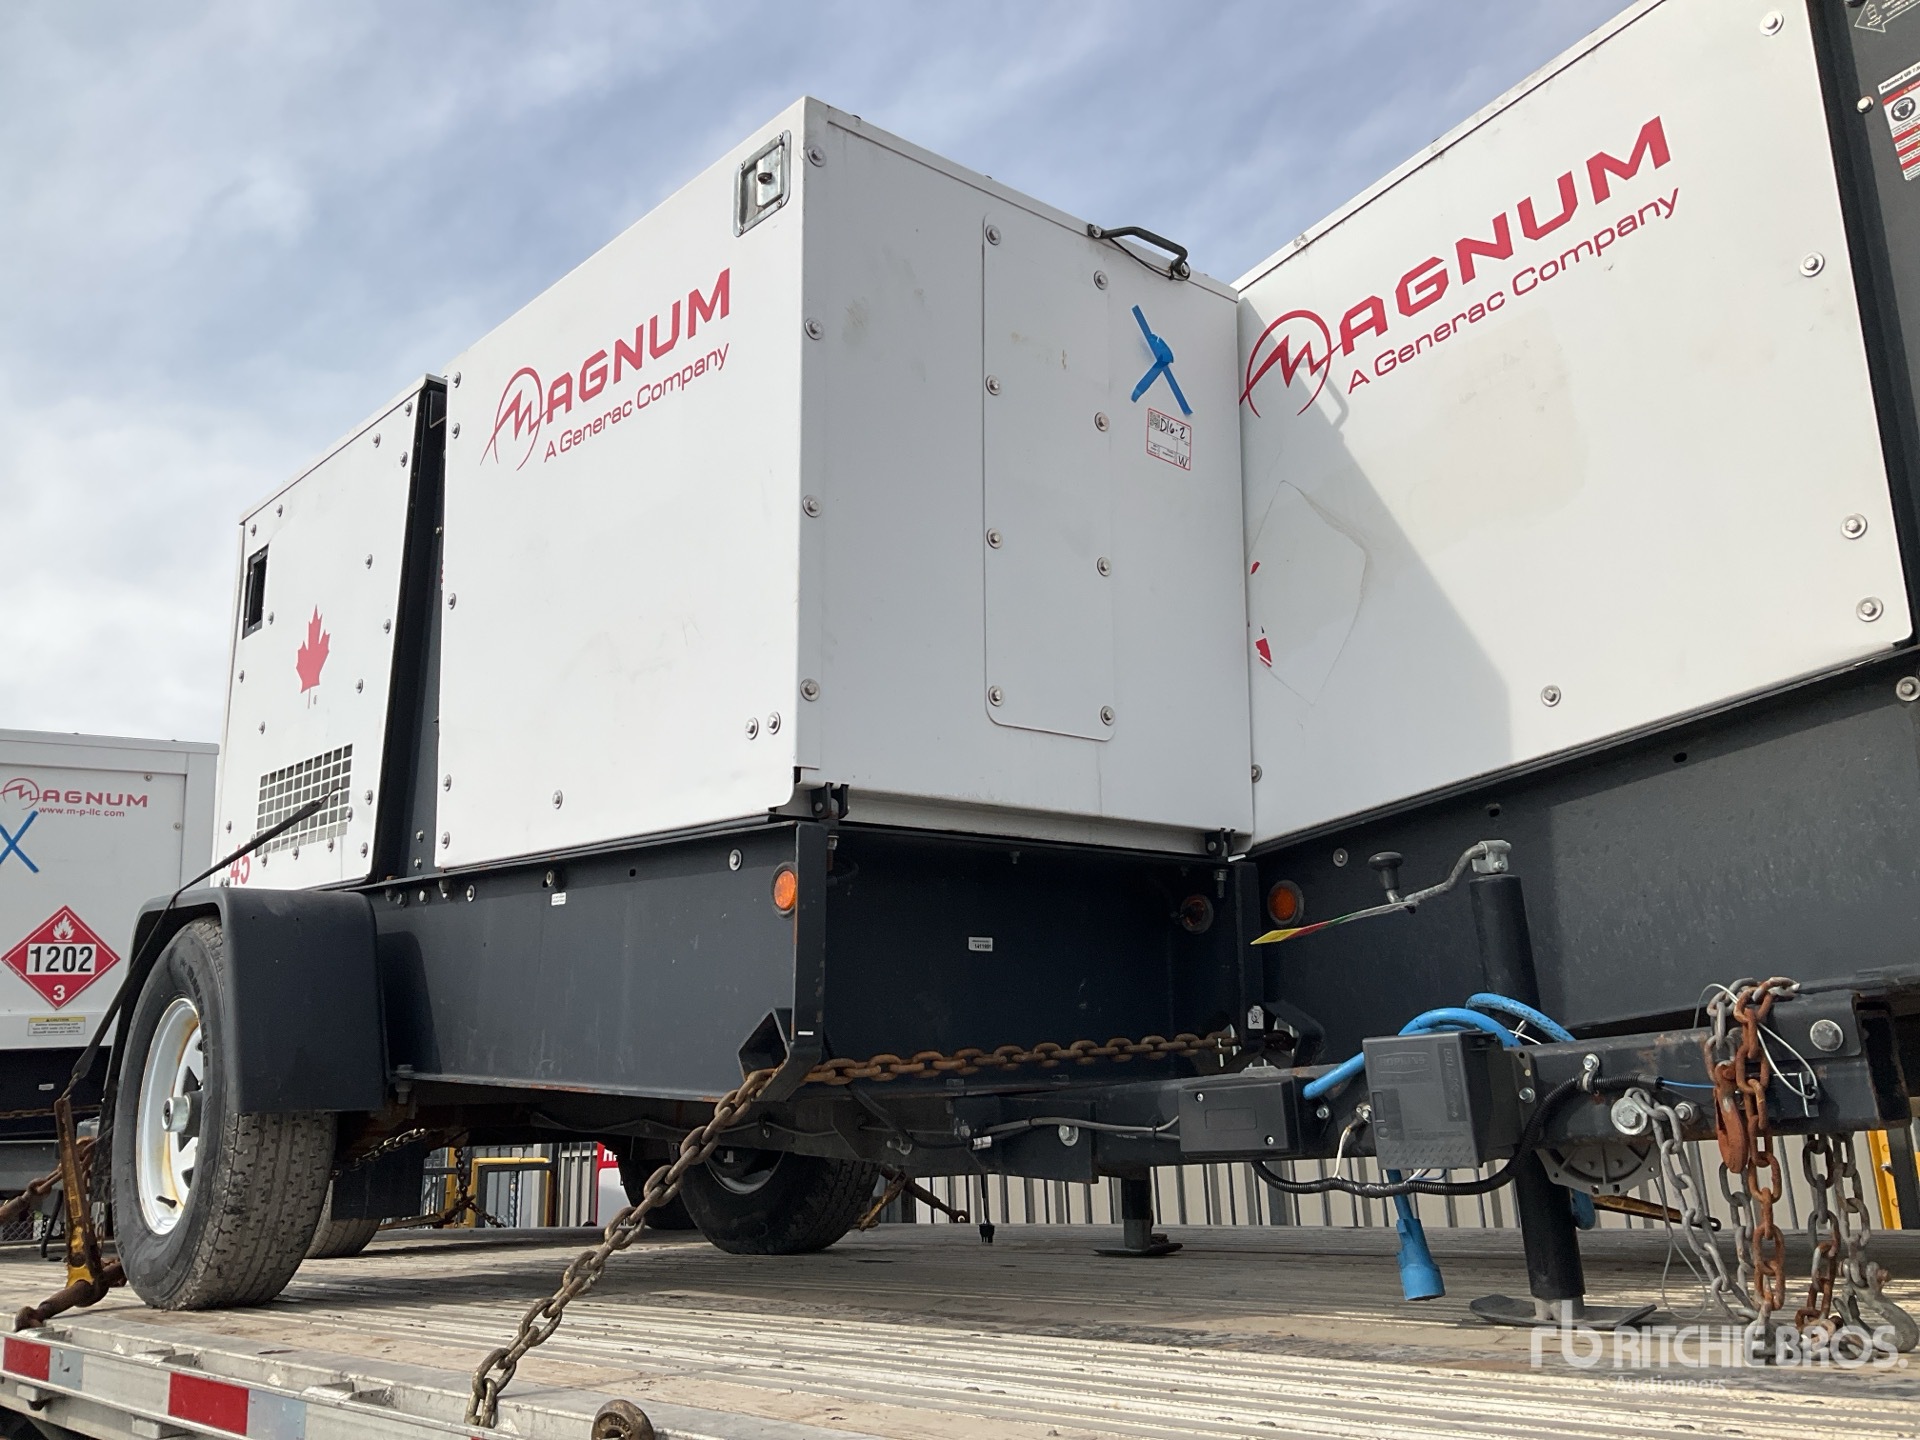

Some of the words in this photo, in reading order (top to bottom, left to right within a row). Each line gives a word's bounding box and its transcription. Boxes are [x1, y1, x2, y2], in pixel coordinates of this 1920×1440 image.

[1239, 116, 1671, 418] MAGNUM
[1348, 370, 1370, 394] A
[1374, 292, 1505, 377] Generac
[1512, 188, 1678, 296] Company
[480, 267, 730, 471] MAGNUM
[544, 441, 556, 463] A
[560, 400, 632, 452] Generac
[637, 343, 729, 409] Company
[0, 778, 148, 810] MAGNUM
[38, 806, 125, 817] www.m-p-llc.com
[30, 945, 93, 973] 1202
[53, 985, 65, 1001] 3
